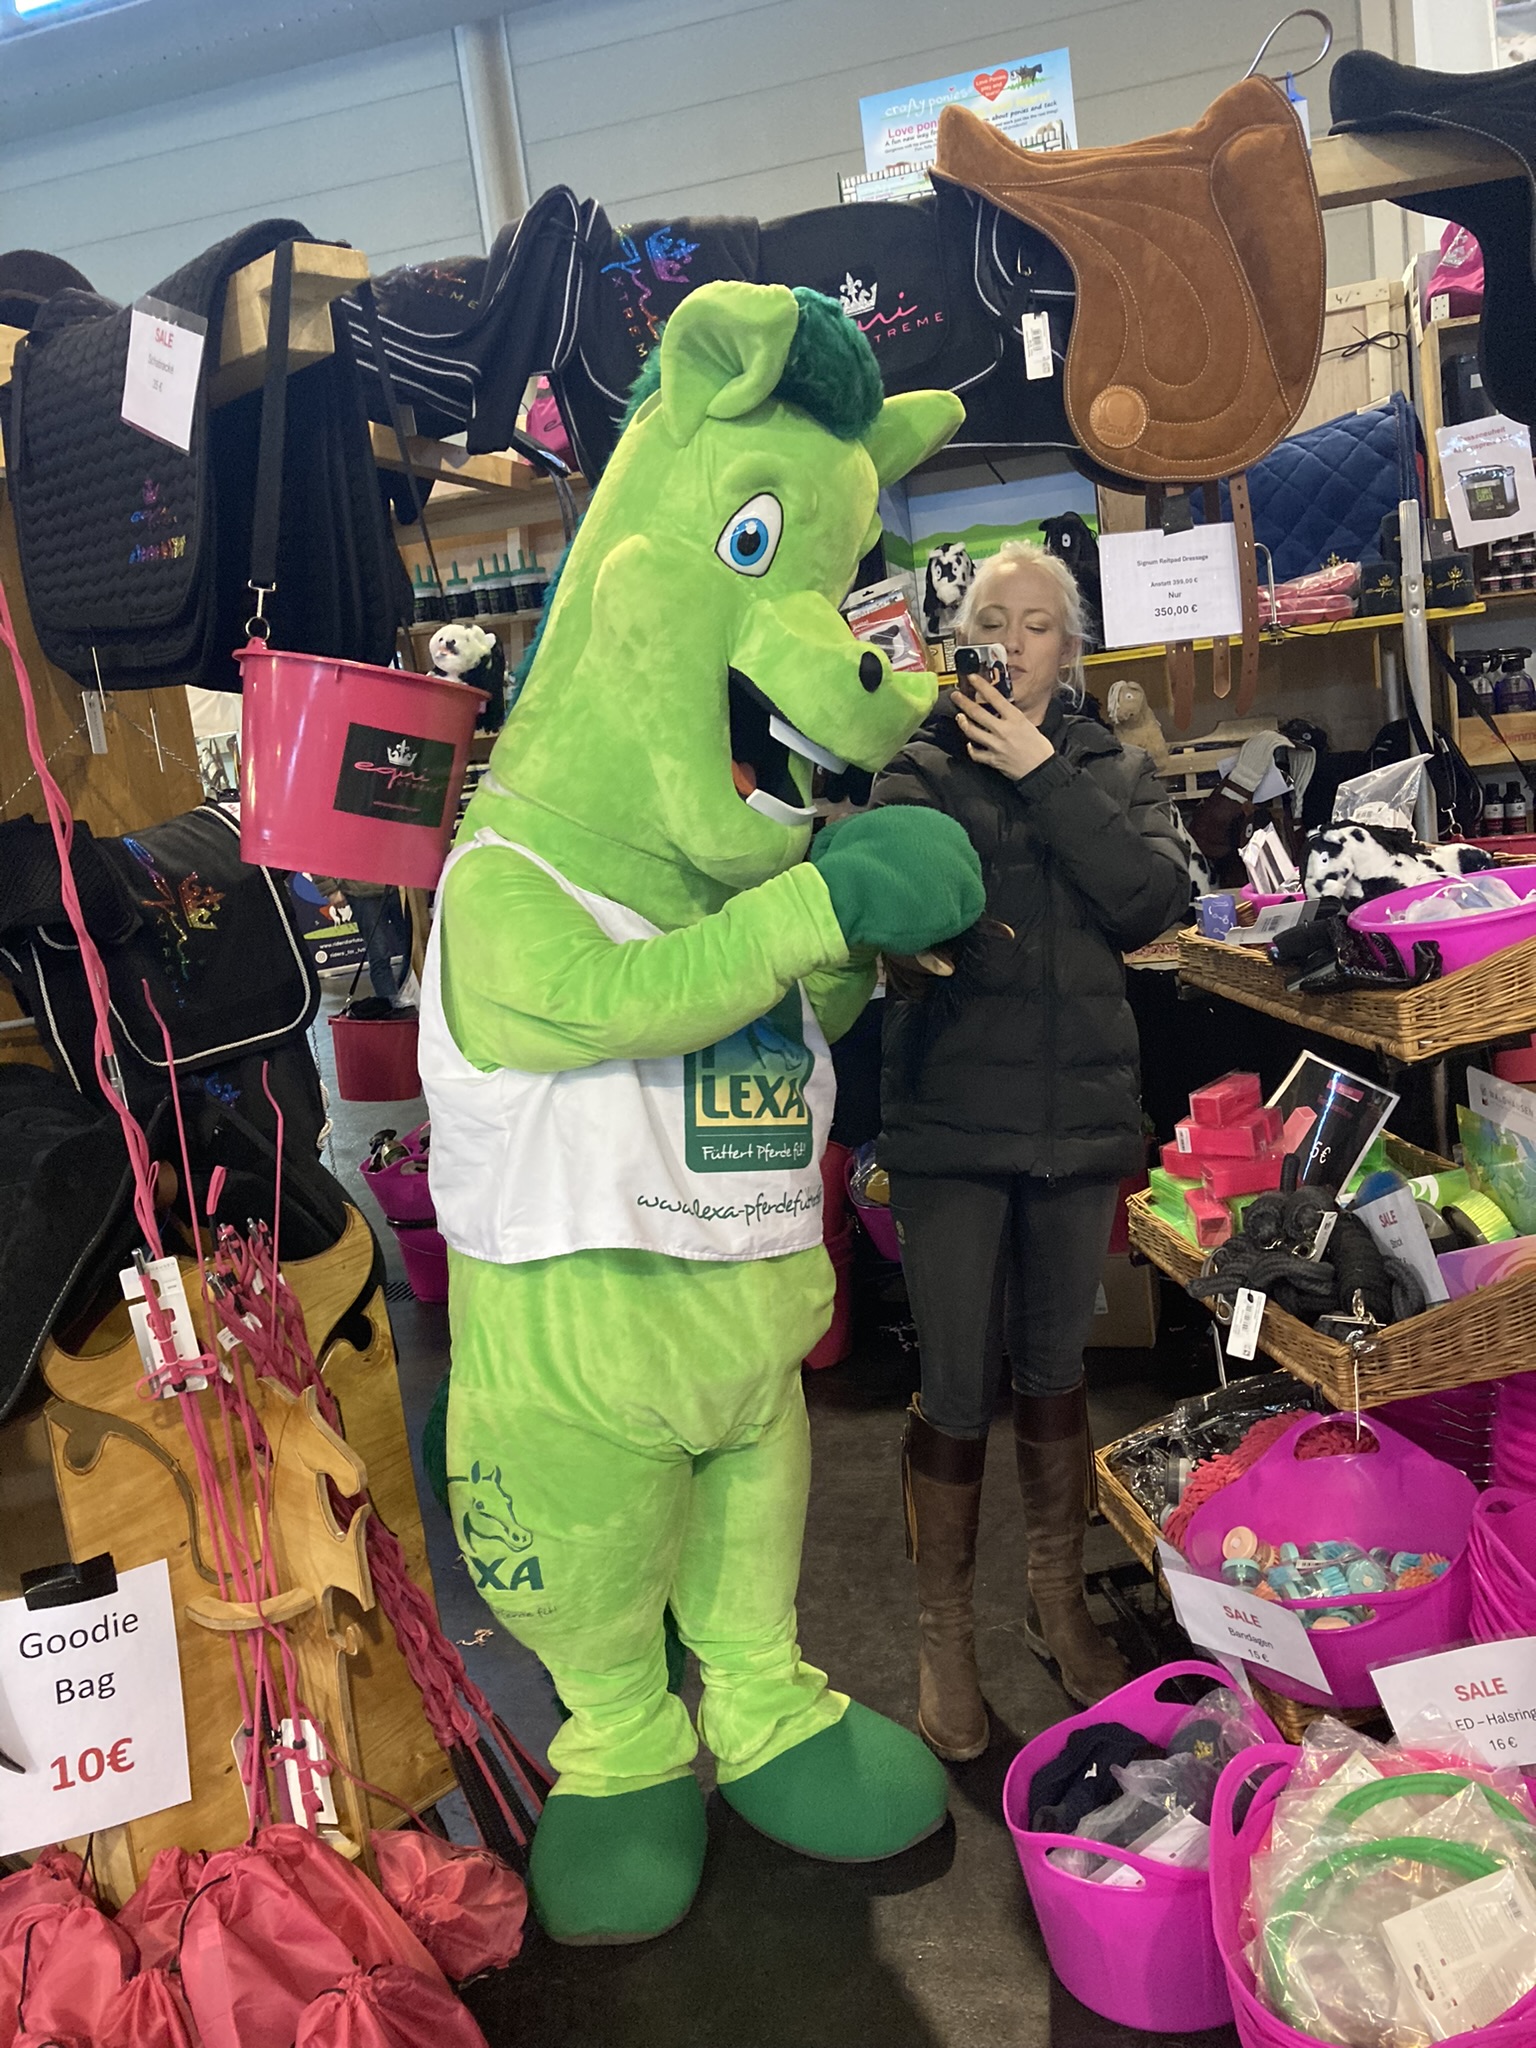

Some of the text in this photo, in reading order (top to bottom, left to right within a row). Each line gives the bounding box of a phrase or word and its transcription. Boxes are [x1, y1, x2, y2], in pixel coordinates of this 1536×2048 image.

[885, 88, 969, 118] crafty ponies
[992, 113, 1008, 121] about
[1010, 108, 1029, 118] ponies
[888, 125, 913, 138] Love
[917, 120, 938, 133] pon
[611, 276, 648, 357] XTREM
[873, 311, 944, 343] TREME
[155, 327, 174, 349] SALE
[1137, 554, 1208, 567] Signum Reitpad Dressage
[1150, 579, 1171, 588] Anstatt
[1155, 604, 1198, 617] 350,00 €
[354, 761, 430, 790] equi
[702, 1075, 805, 1119] LEXA
[702, 1142, 806, 1162] Füttert Pferde fit!
[1379, 1210, 1398, 1228] SALE
[470, 1556, 544, 1591] XA
[1223, 1605, 1262, 1628] SALE
[19, 1612, 139, 1660] Goodie
[1228, 1627, 1274, 1650] Bandagen
[1248, 1649, 1270, 1663] 15 €
[55, 1671, 116, 1705] Bag
[1454, 1677, 1509, 1702] SALE
[1489, 1736, 1518, 1751] 16 €
[50, 1737, 135, 1792] 10€
